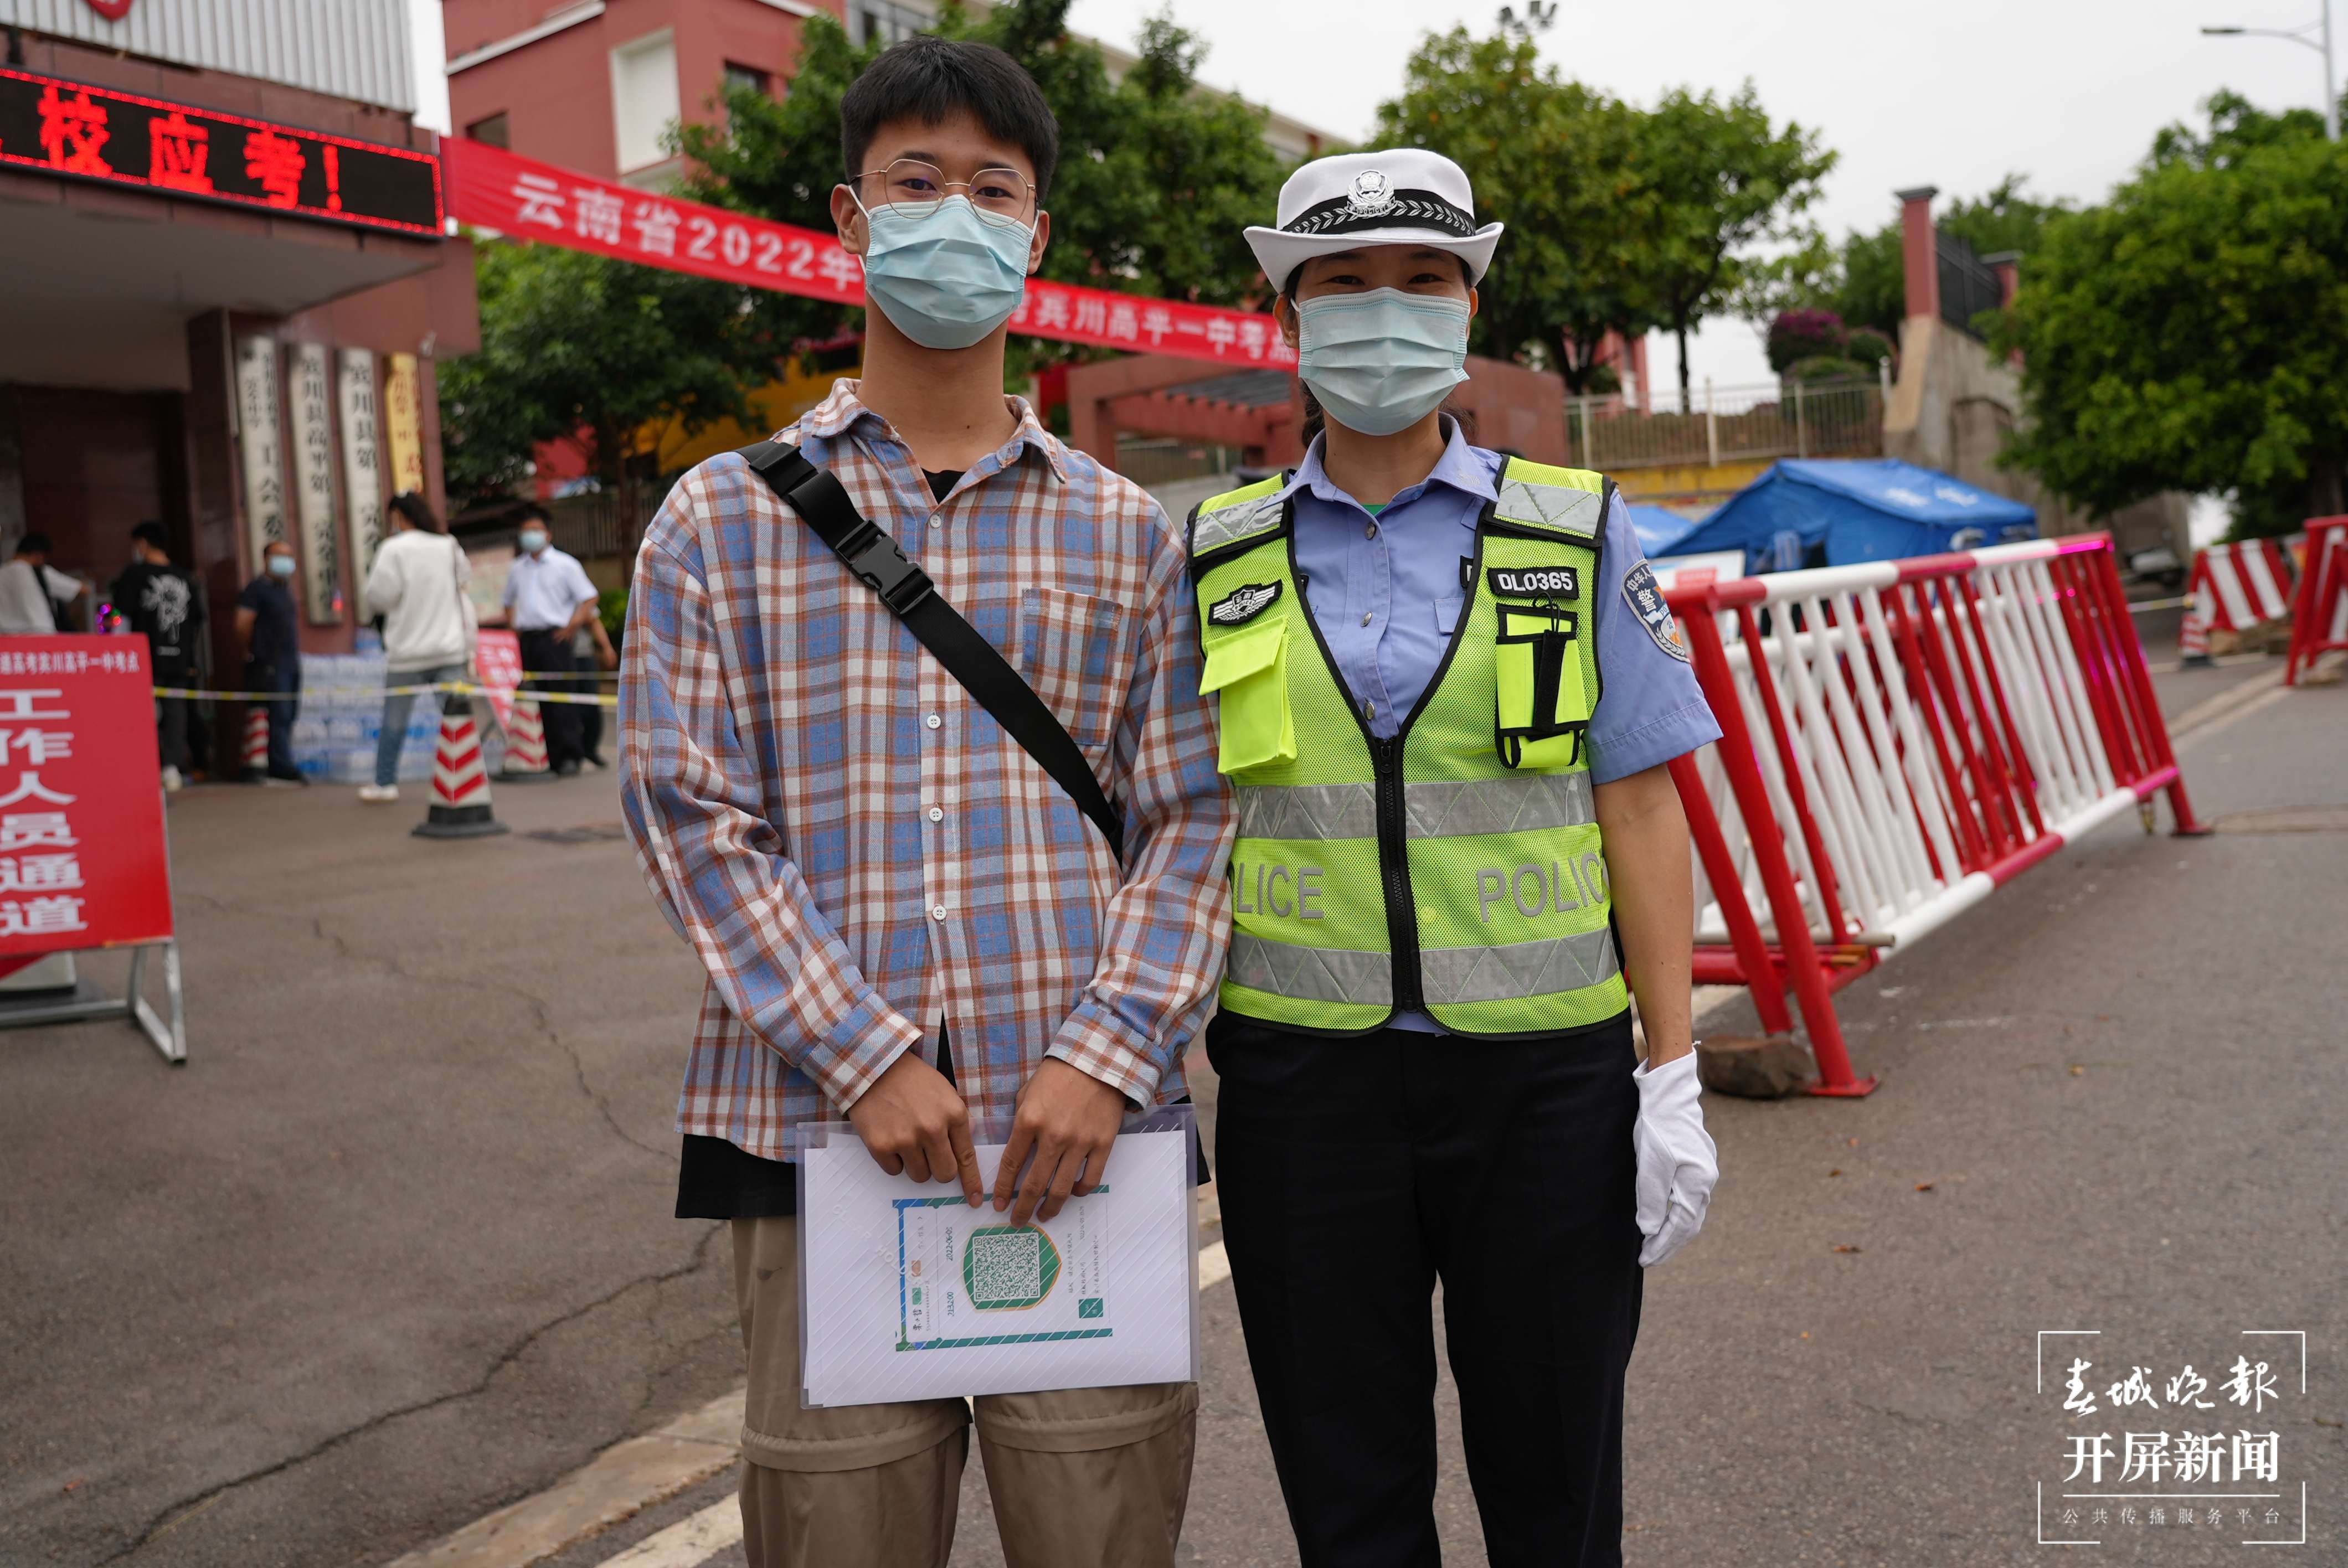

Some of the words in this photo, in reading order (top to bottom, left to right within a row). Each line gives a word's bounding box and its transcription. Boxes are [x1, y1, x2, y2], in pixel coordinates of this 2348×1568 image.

[511, 171, 862, 292] 云南省2022年
[0, 688, 89, 937] 工作人员通道
